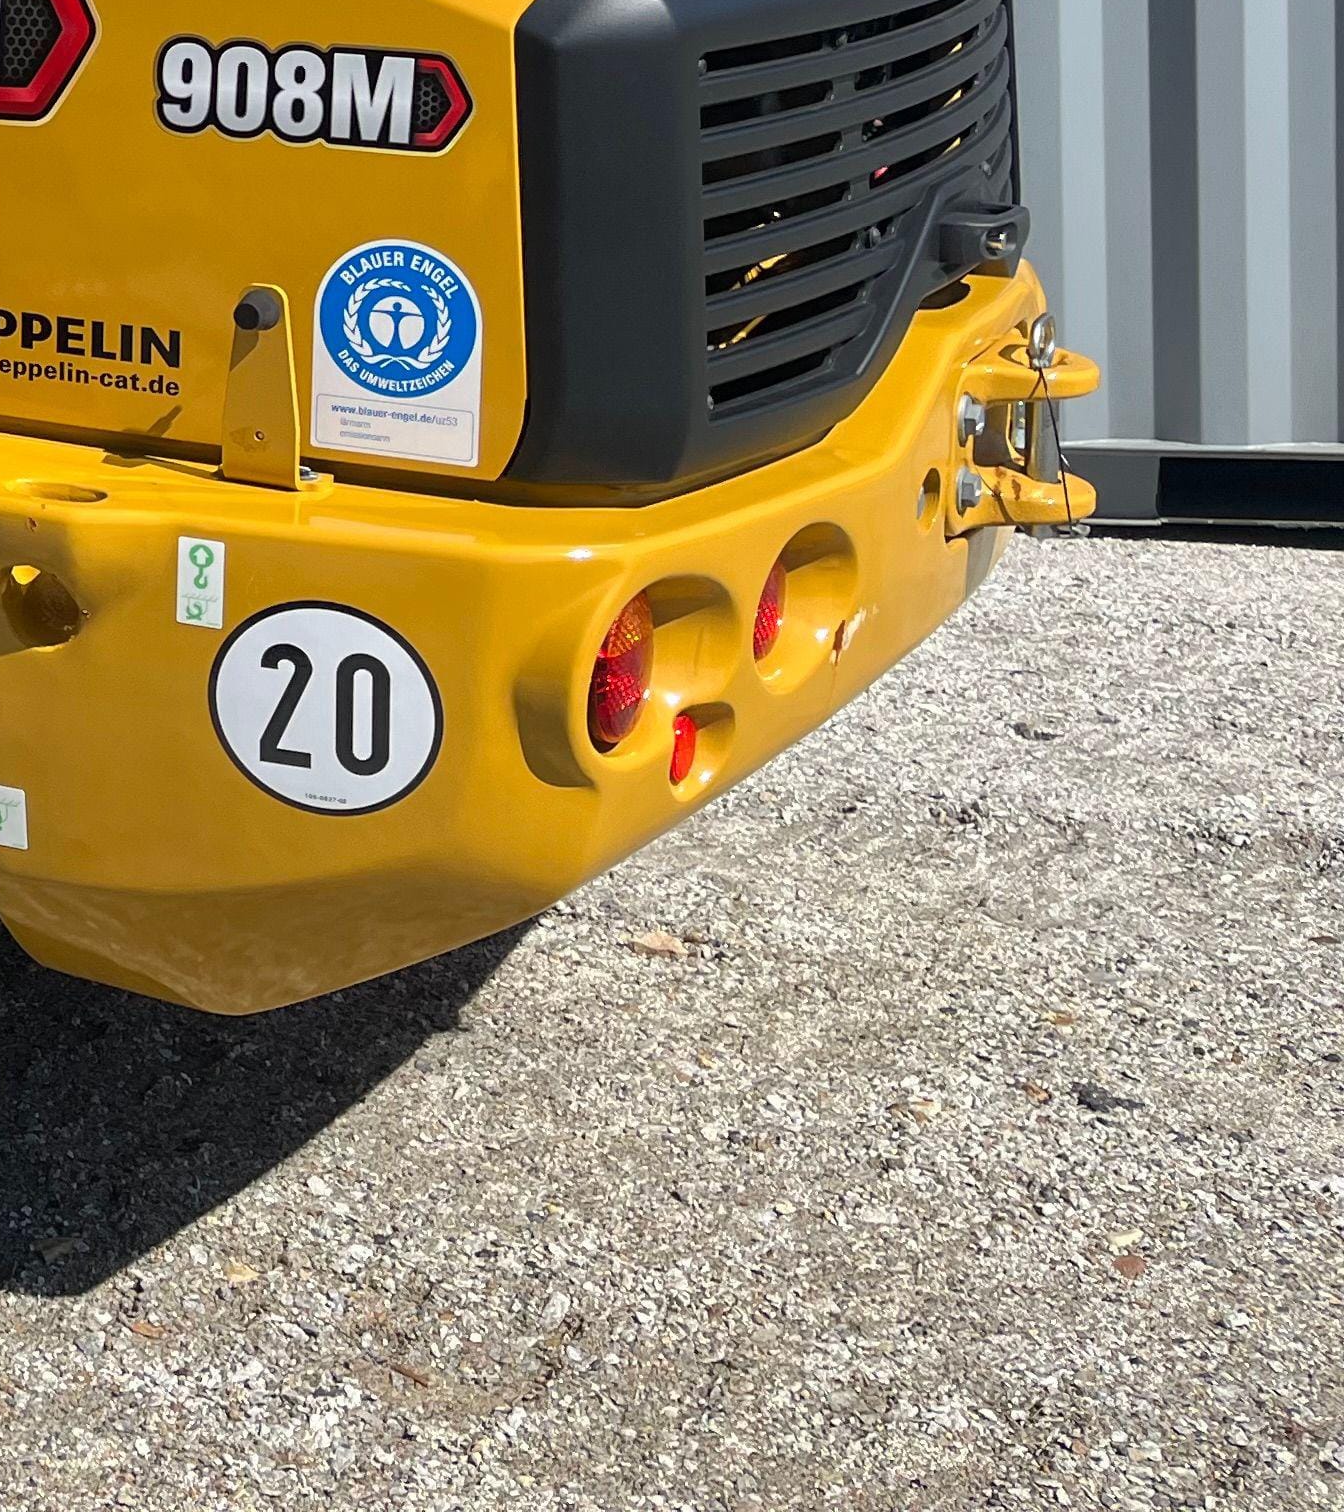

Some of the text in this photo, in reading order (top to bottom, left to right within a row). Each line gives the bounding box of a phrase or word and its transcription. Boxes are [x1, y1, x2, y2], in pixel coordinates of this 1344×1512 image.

[161, 41, 416, 145] 908M
[339, 250, 460, 300] BLAUER ENGEL
[337, 348, 456, 393] DAS UMWELTZEICHEN
[330, 402, 459, 427] www.blauer-engel.de/uz53
[259, 643, 391, 777] 20
